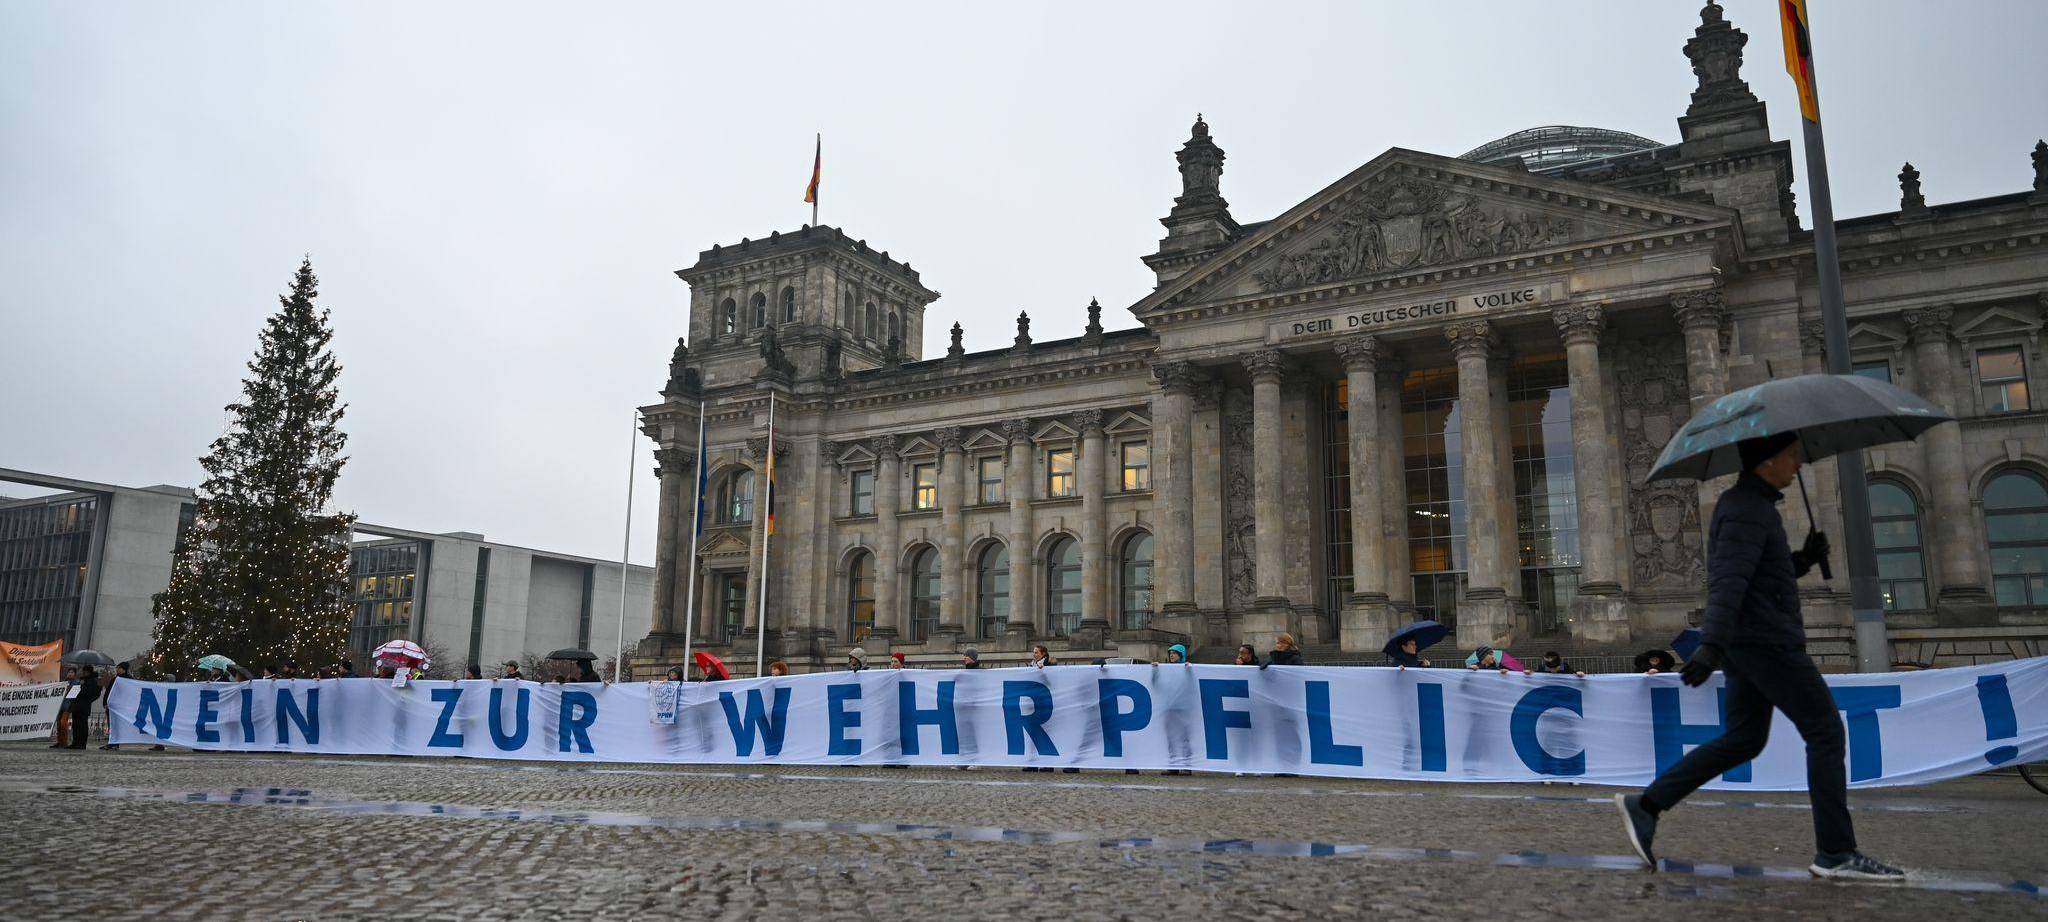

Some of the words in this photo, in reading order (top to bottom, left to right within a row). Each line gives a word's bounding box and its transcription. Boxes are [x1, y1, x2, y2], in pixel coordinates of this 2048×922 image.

[1293, 318, 1333, 335] DEM
[1347, 300, 1457, 328] DEUTSCHEN
[1473, 289, 1535, 308] VOLKE
[12, 690, 33, 700] EINZIGE
[50, 687, 65, 697] ABER
[133, 687, 320, 745] NEIN
[427, 688, 598, 754] ZUR
